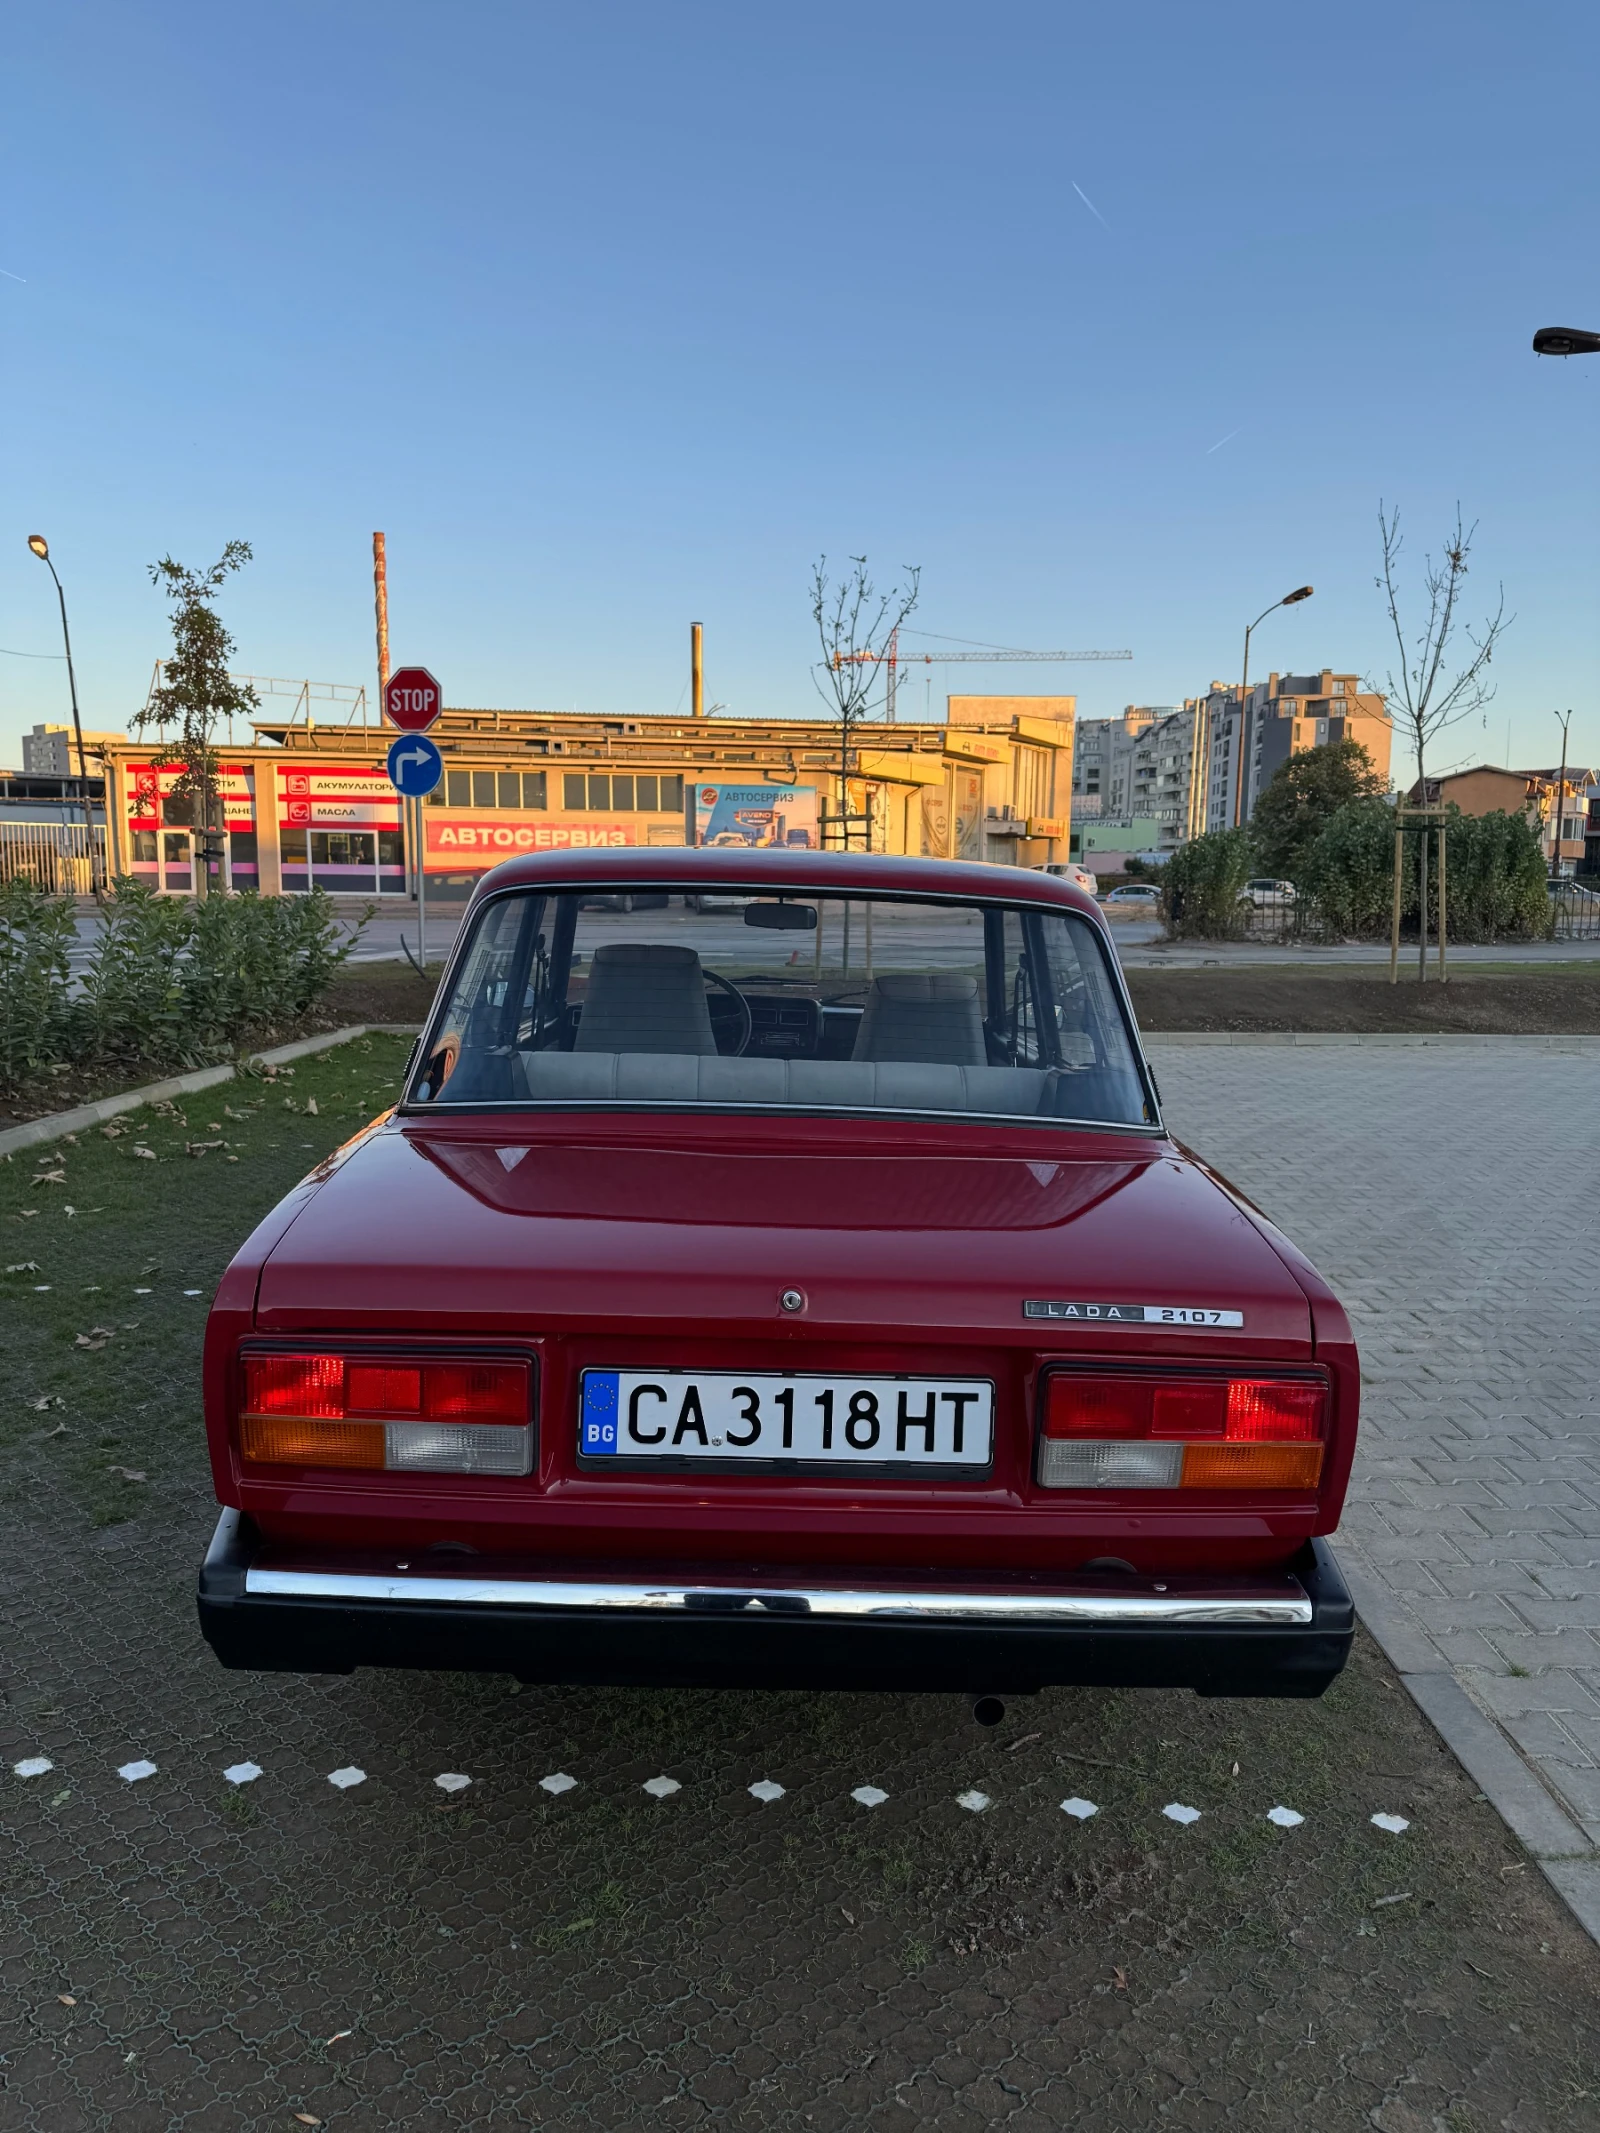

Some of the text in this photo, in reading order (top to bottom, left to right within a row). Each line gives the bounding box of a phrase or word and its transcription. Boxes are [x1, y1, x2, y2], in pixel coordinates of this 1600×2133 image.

[390, 688, 435, 712] STOP
[725, 792, 794, 803] АВТОСЕРВИЗ
[317, 808, 356, 816] МАСЛА
[438, 827, 627, 847] АВТОСЕРВИЗ
[1048, 1304, 1222, 1323] LADA 2107
[587, 1424, 615, 1443] BG
